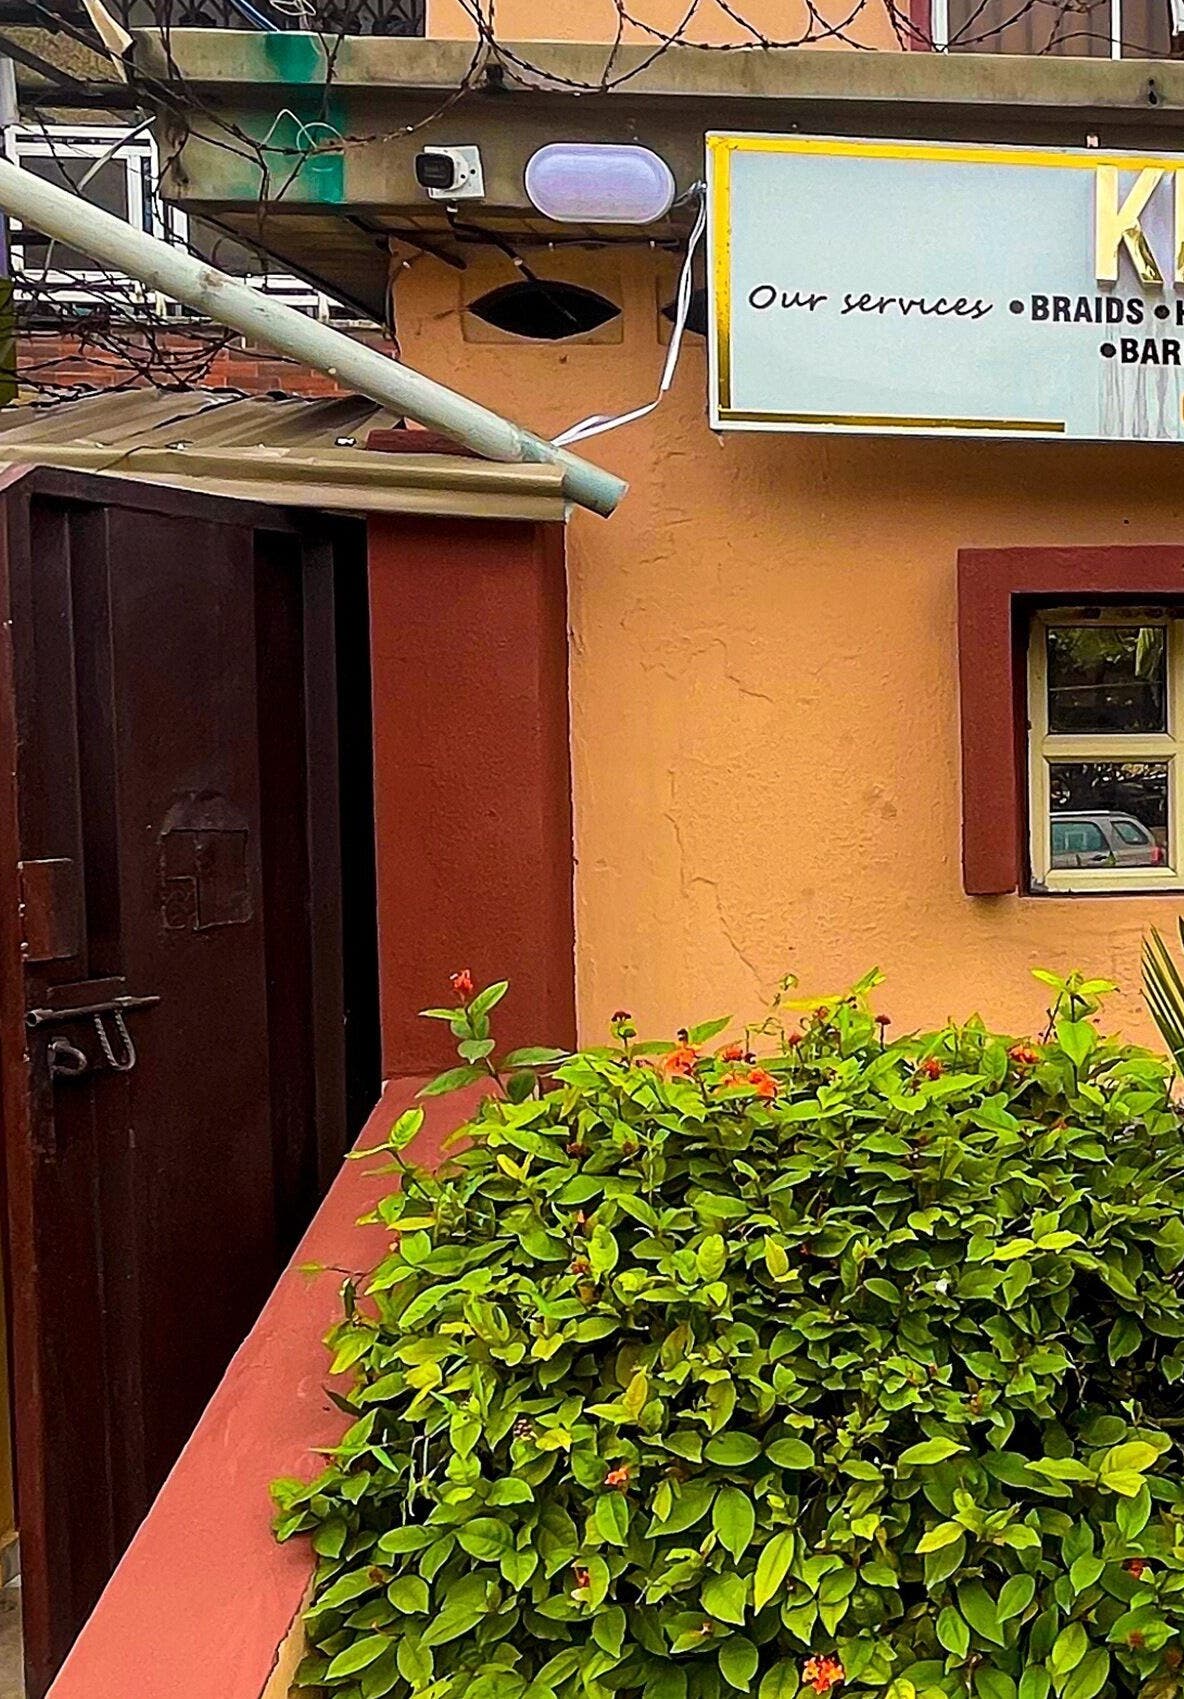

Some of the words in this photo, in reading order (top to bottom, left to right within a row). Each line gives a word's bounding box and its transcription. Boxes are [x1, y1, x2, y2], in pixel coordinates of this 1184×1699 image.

[749, 284, 828, 310] Our
[840, 291, 994, 320] services
[1030, 296, 1144, 324] BRAIDS
